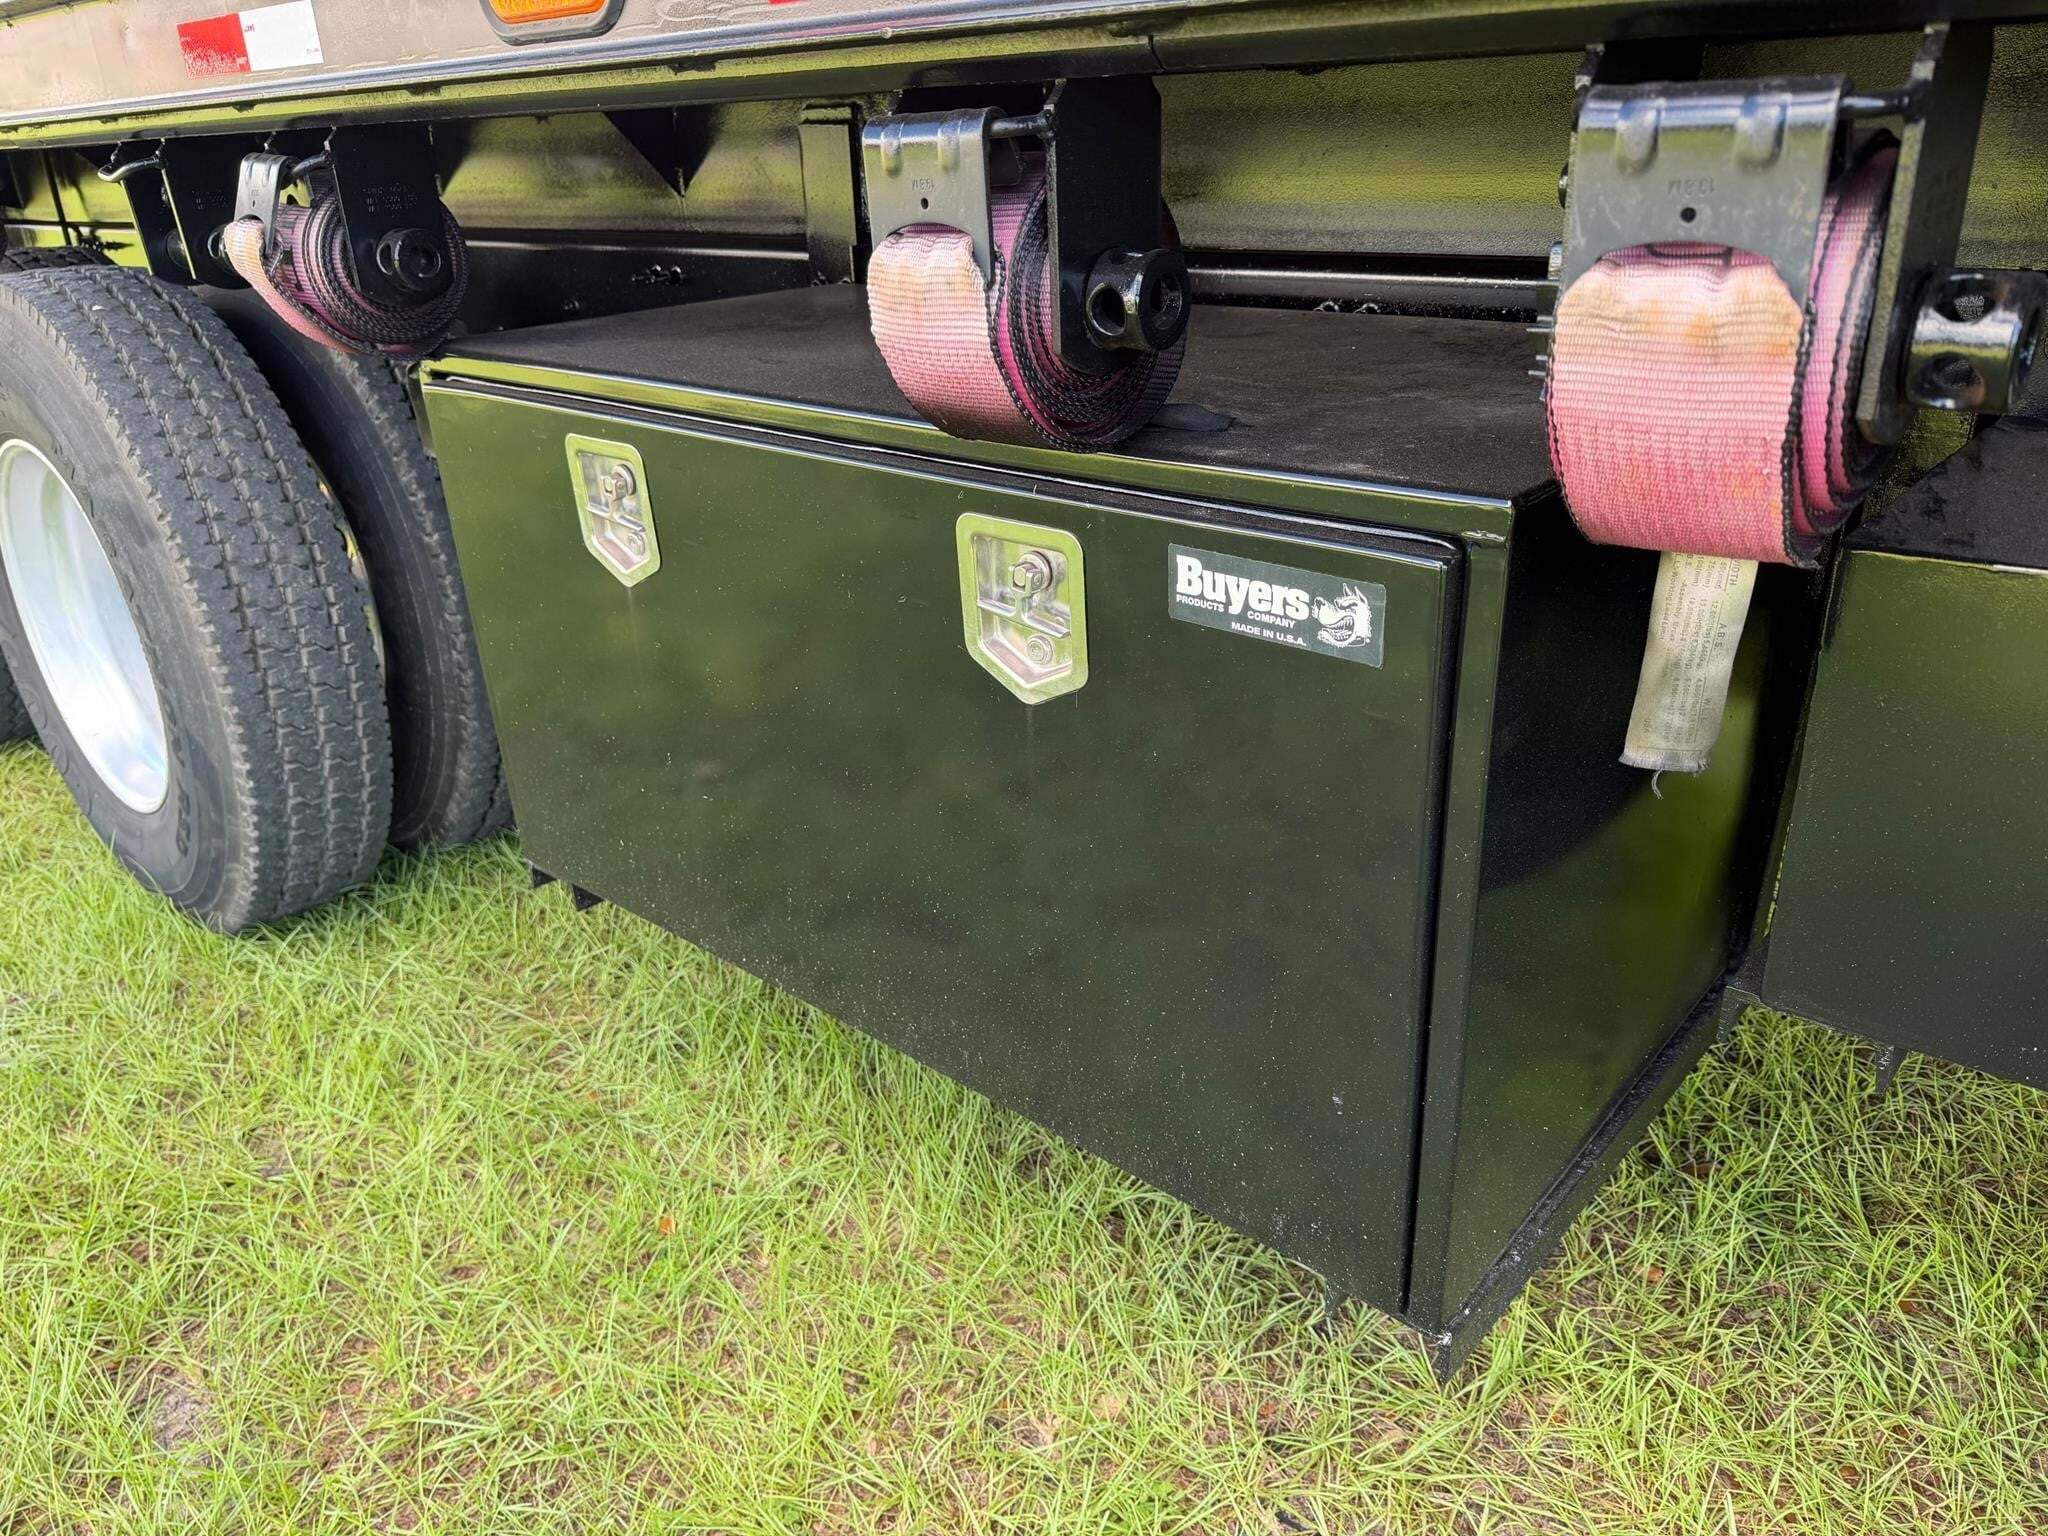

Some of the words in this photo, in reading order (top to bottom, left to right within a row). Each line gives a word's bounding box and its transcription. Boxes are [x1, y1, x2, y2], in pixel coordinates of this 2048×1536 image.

[1176, 554, 1309, 621] Buyers
[1176, 594, 1224, 612] PRODUCTS
[1247, 611, 1297, 629] COMPANY
[1231, 622, 1260, 636] MADE
[1262, 629, 1275, 639] IN
[1276, 631, 1307, 647] U.S.A.
